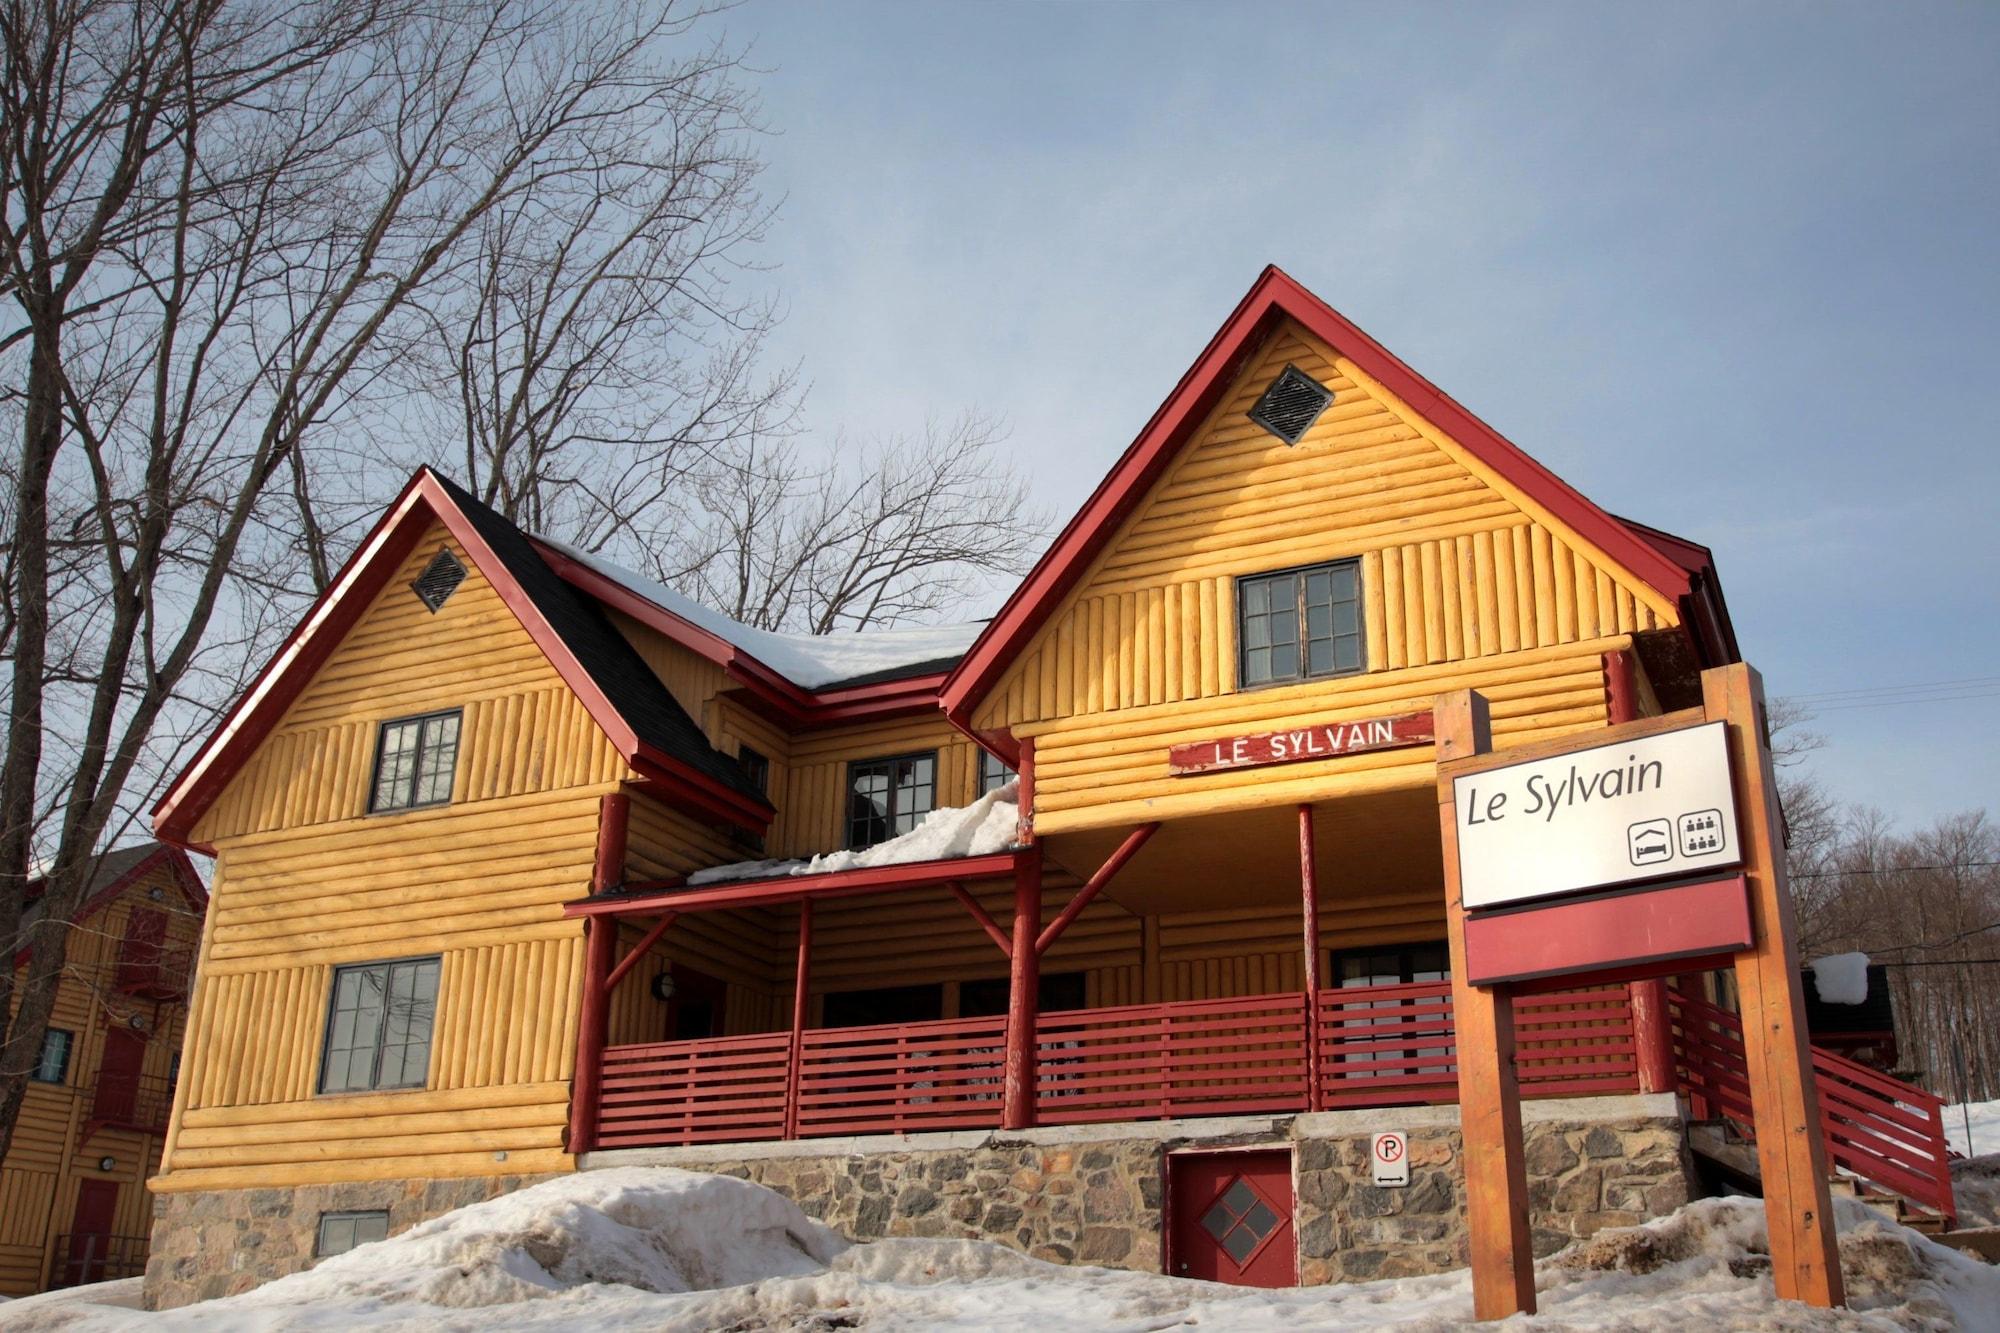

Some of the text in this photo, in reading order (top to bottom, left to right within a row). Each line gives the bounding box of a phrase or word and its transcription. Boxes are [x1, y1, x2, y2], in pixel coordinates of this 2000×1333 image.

[1215, 720, 1394, 766] LE SYLVAIN
[1467, 754, 1663, 826] Le Sylvain
[1385, 1140, 1396, 1157] P
